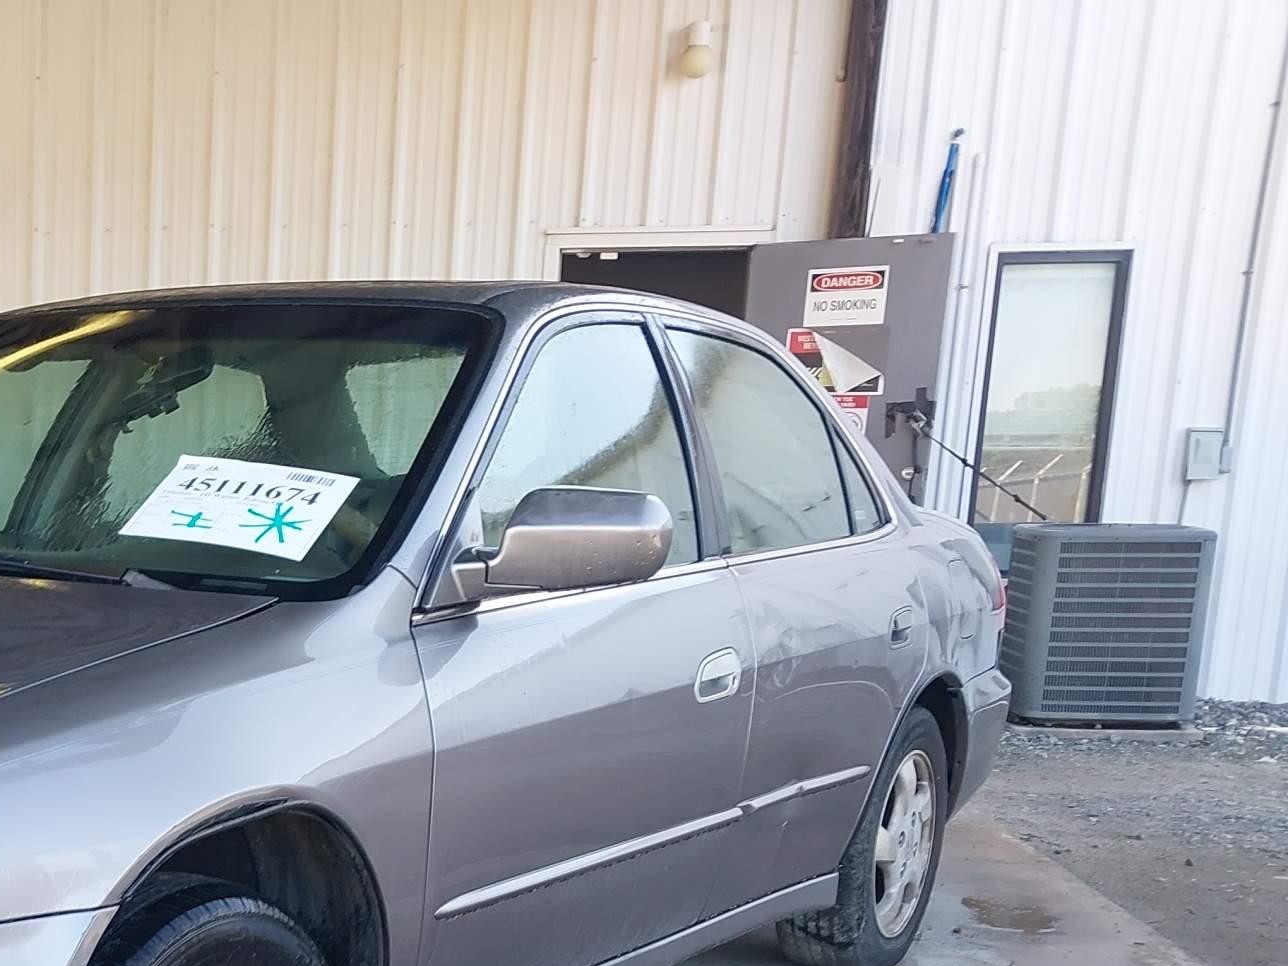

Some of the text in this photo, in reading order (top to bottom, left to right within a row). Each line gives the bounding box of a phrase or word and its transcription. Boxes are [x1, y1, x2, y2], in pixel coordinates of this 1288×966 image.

[820, 275, 874, 288] DANGER
[813, 298, 877, 312] NO SMOKING
[178, 476, 322, 506] 45111674
